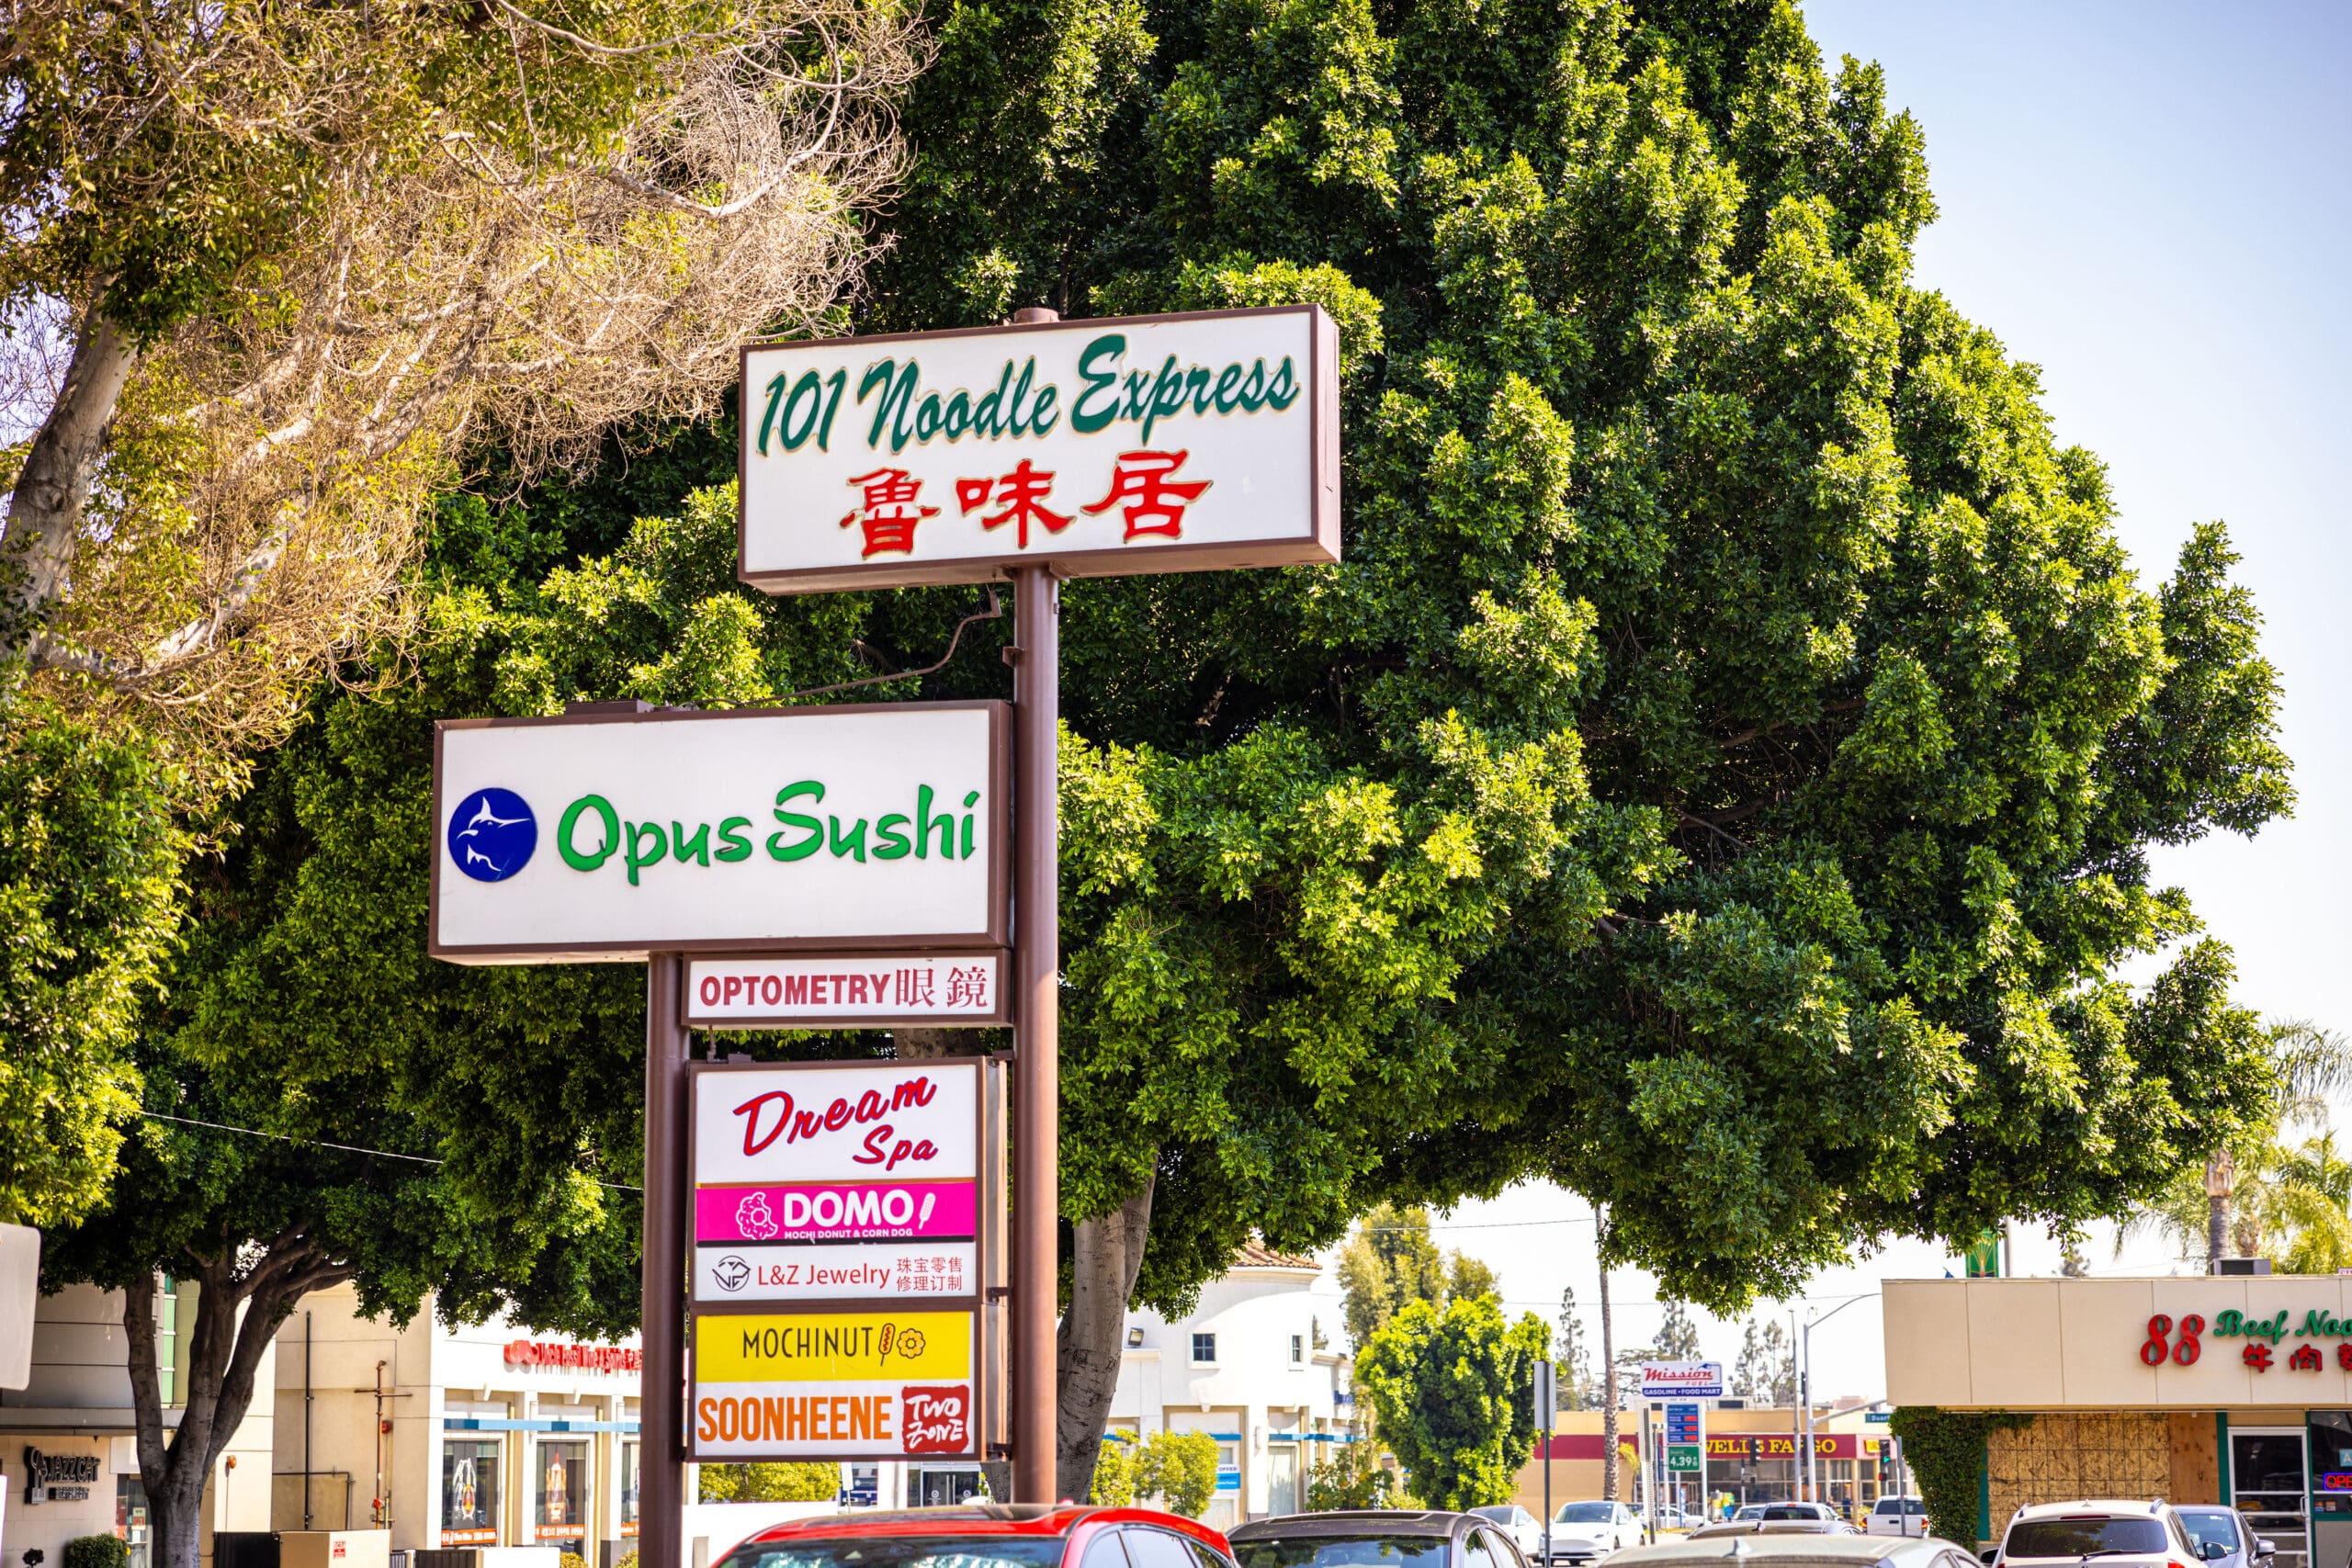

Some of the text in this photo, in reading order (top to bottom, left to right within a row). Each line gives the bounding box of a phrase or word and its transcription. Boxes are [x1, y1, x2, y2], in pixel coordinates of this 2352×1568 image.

[756, 333, 1301, 457] 101 Noodle Express
[840, 448, 1214, 558] 魯味居
[558, 781, 979, 886] Opus Sushi
[700, 966, 988, 1008] OPTOMETRY 眼鏡
[732, 1077, 937, 1156] Dream
[853, 1124, 939, 1171] Spa
[784, 1190, 914, 1228] DOMO
[785, 1228, 913, 1240] MOCHI DONUT & CORN DOG
[758, 1263, 891, 1290] L&Z Jewelry
[897, 1257, 963, 1274] 珠宝零售
[897, 1274, 963, 1292] 修理订制
[742, 1327, 874, 1359] MOCHINUT
[2140, 1314, 2205, 1366] 88
[2213, 1310, 2290, 1345] Beef
[1644, 1367, 1713, 1381] Mission
[698, 1396, 893, 1442] SOONHEENE
[905, 1395, 961, 1418] TWO
[905, 1420, 964, 1449] ZONE
